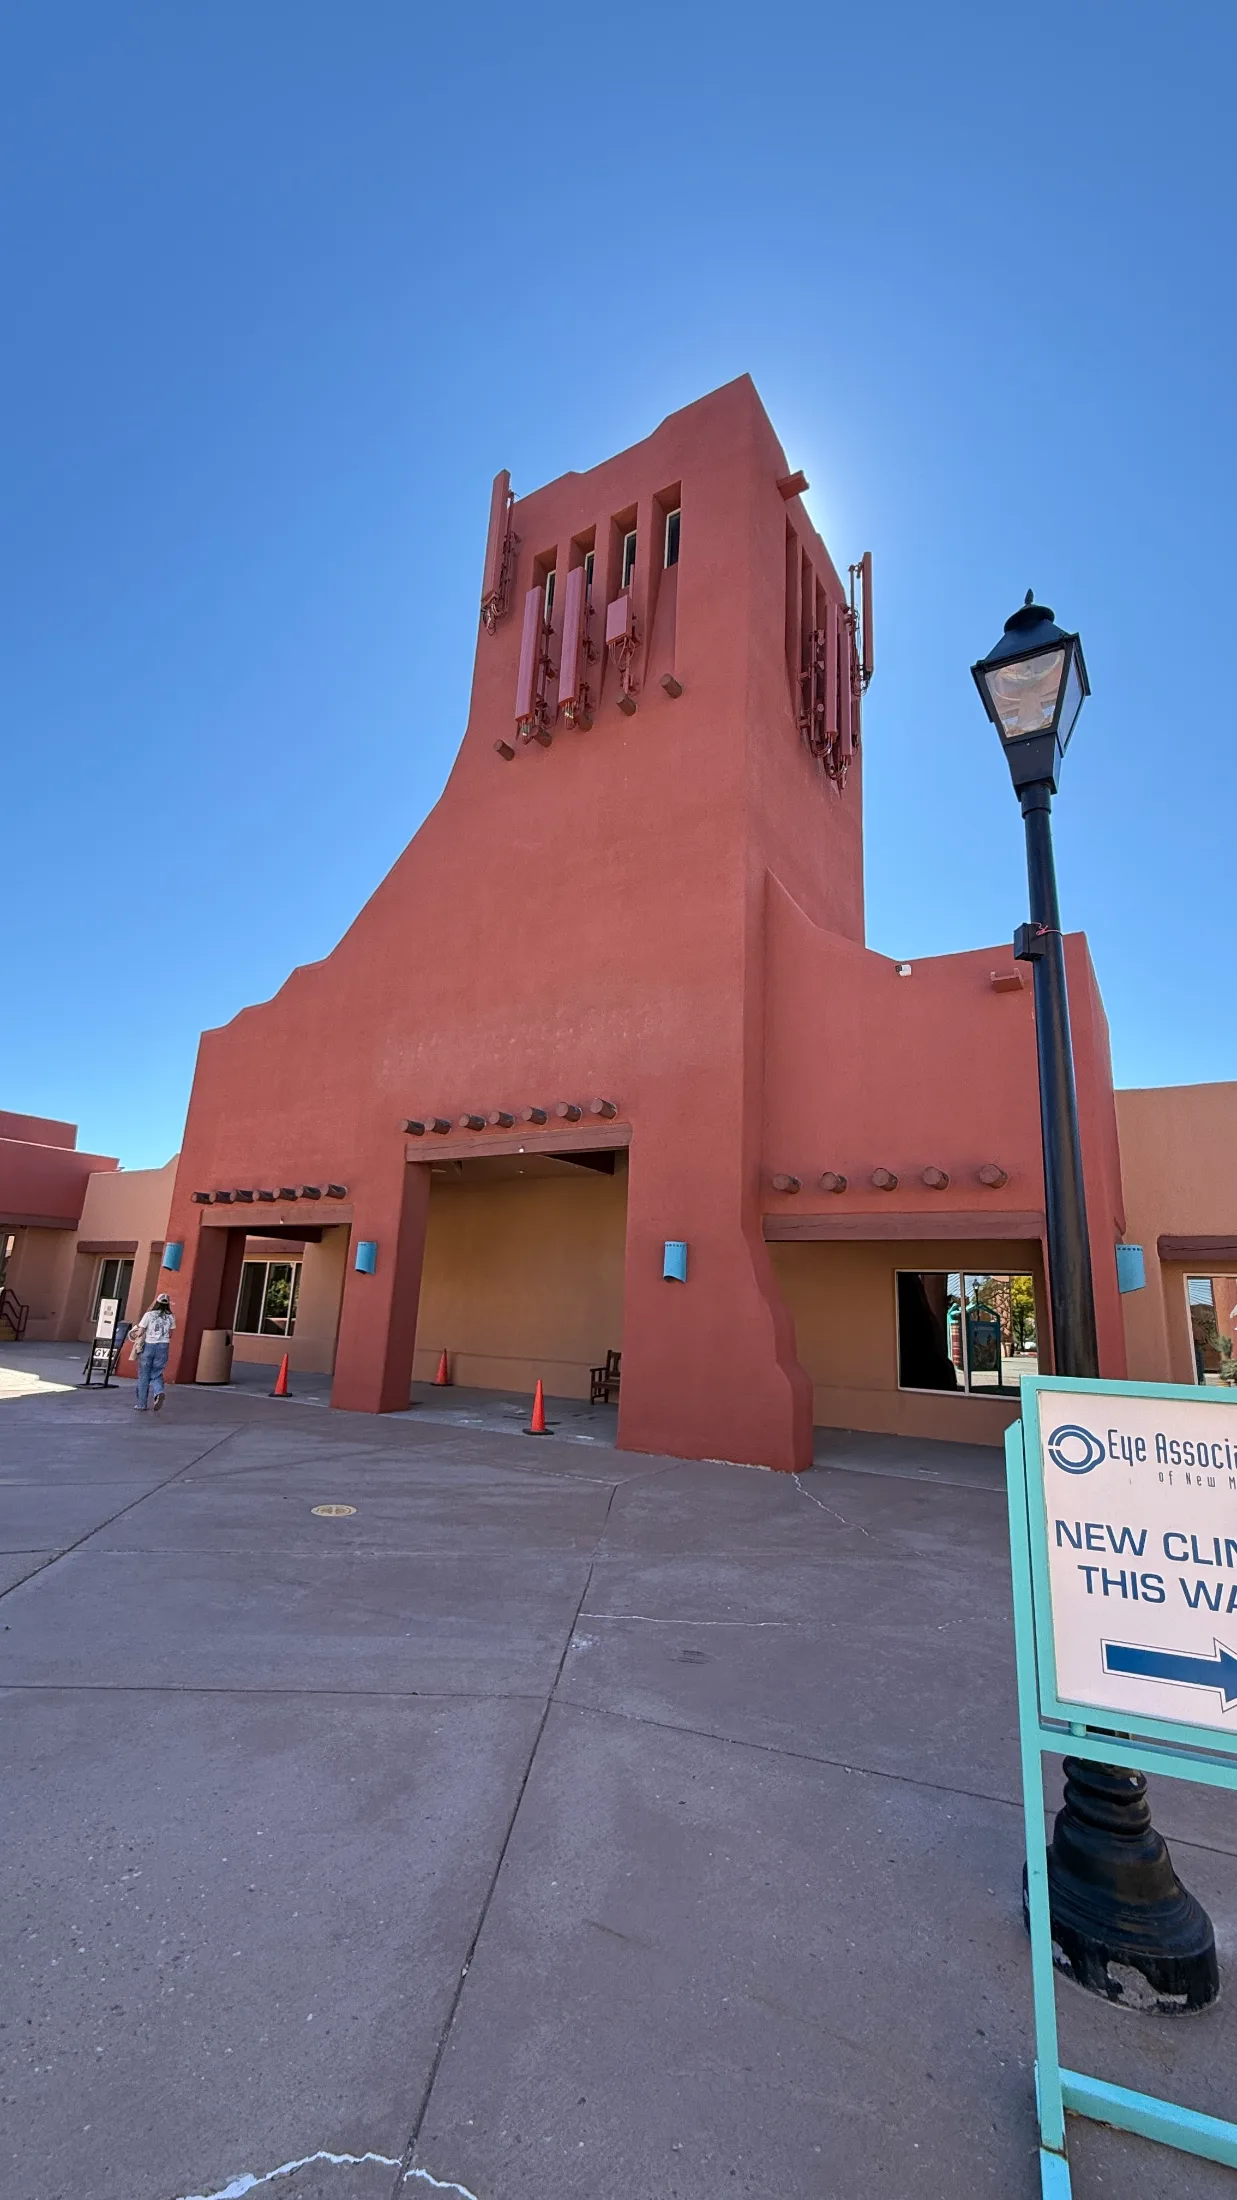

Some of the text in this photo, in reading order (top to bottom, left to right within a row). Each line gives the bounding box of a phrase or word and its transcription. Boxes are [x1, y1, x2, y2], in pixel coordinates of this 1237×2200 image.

[1107, 1429, 1147, 1467] Eye
[1158, 1470, 1173, 1485] of
[1185, 1472, 1216, 1487] New
[1055, 1519, 1148, 1557] NEW
[1077, 1564, 1166, 1604] THIS
